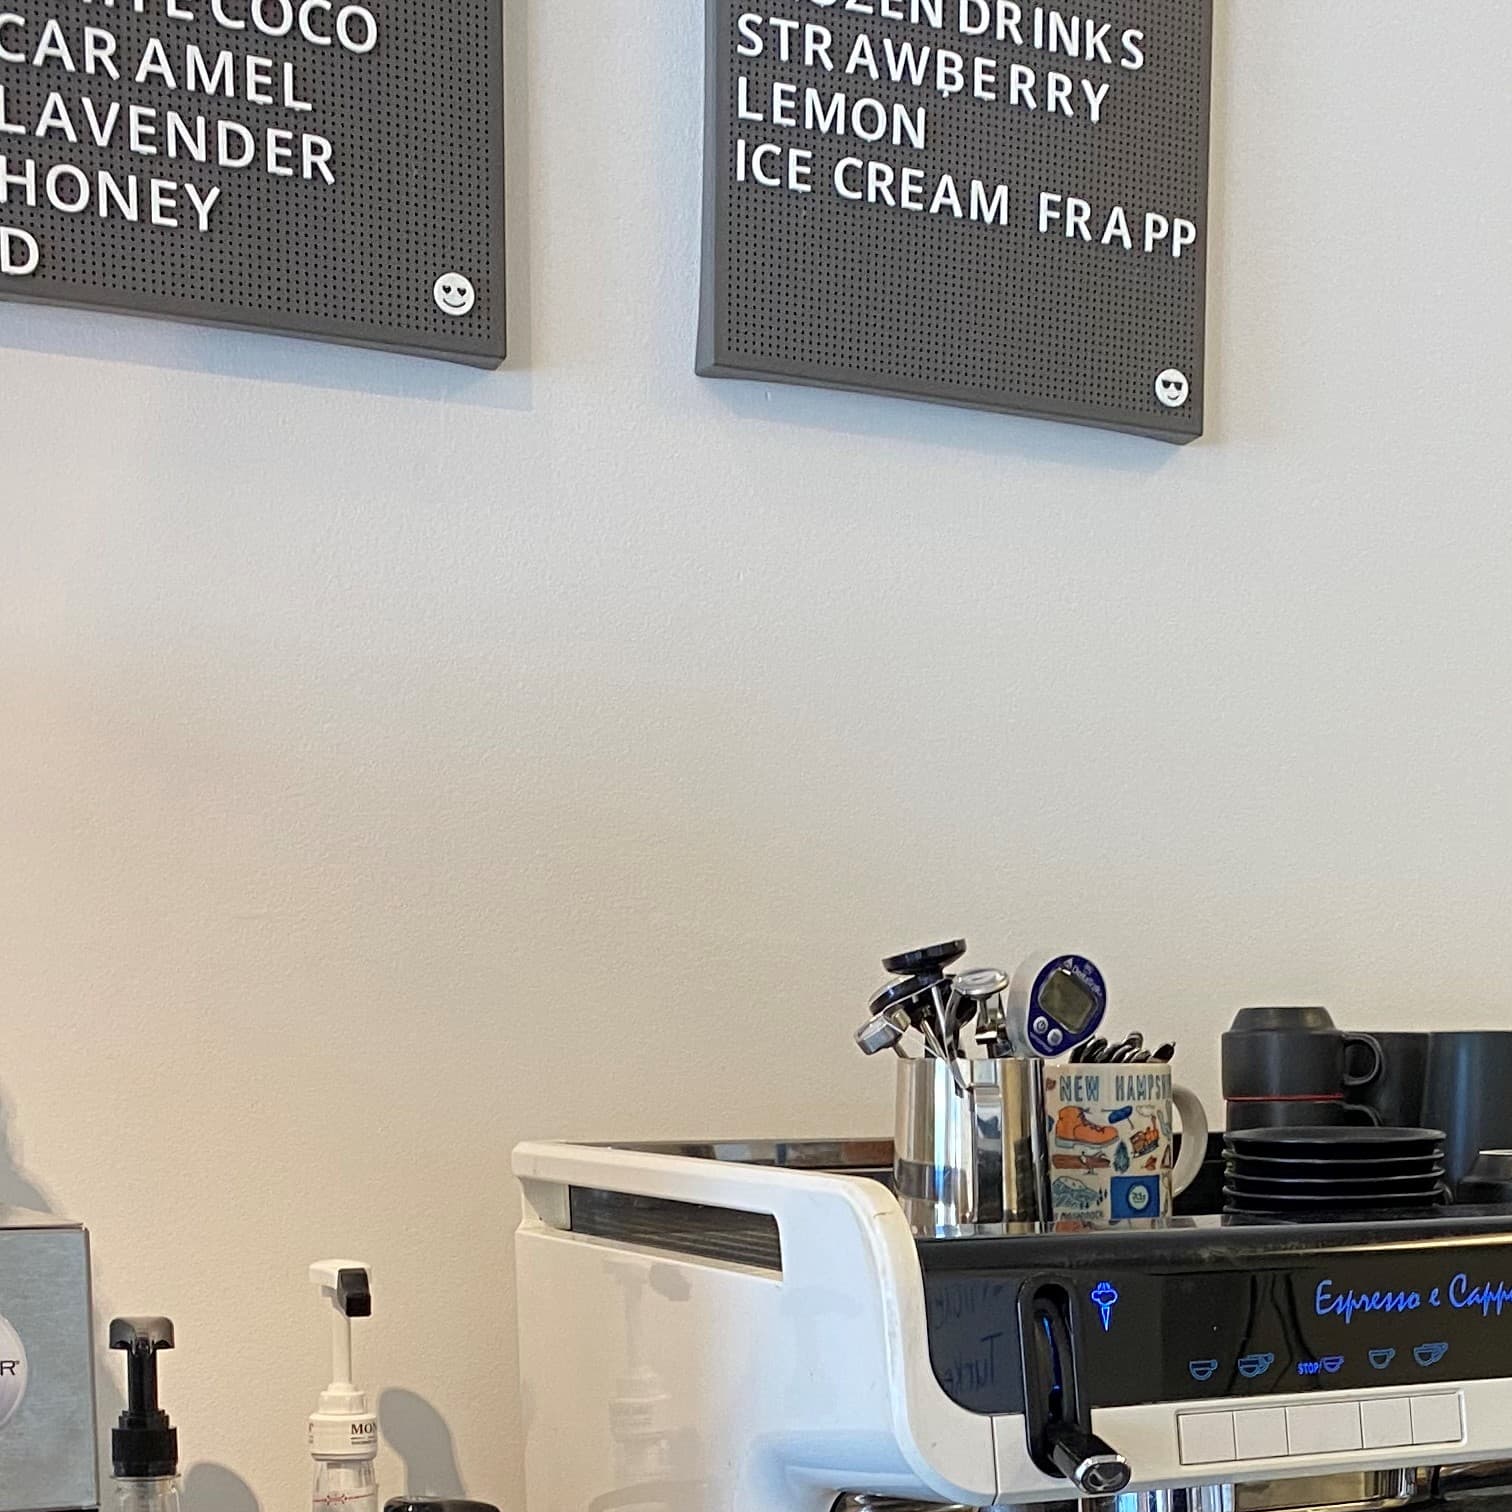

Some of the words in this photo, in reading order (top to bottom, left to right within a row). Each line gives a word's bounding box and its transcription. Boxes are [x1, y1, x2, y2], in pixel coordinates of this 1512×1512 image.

[0, 12, 313, 111] CARAMEL
[737, 13, 1110, 123] STRAWBERRY
[959, 0, 1144, 71] DRINKS
[0, 85, 335, 185] LAVENDER
[737, 76, 926, 149] LEMON
[0, 155, 221, 232] HONEY
[735, 139, 813, 193] ICE
[834, 156, 1010, 227] CREAM
[1038, 191, 1197, 259] FRAPP
[1059, 1075, 1100, 1102] NEW
[1314, 1279, 1420, 1324] Espresso
[1428, 1286, 1441, 1307] e
